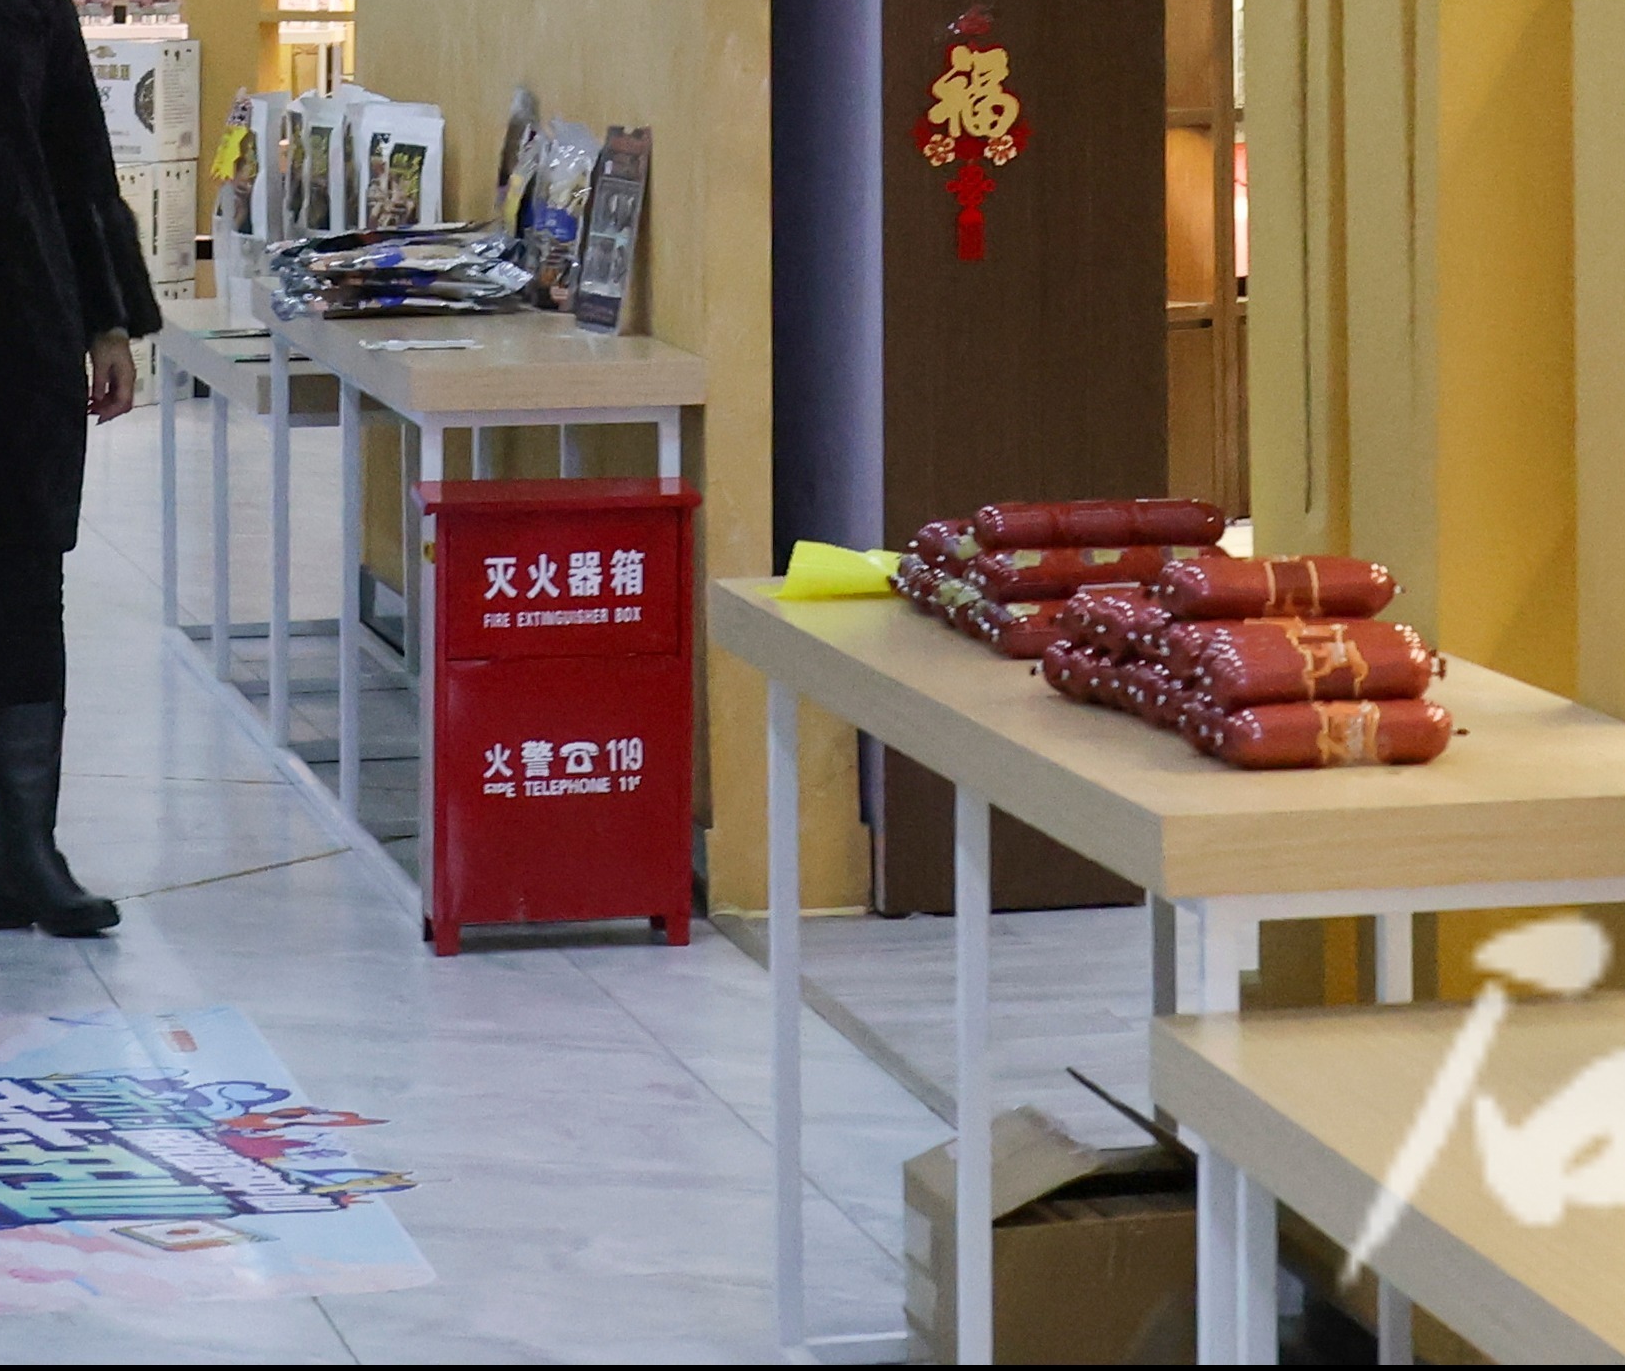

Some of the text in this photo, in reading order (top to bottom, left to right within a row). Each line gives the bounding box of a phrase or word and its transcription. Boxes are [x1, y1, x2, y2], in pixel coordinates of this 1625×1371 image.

[928, 44, 1020, 138] 福
[483, 549, 645, 600] 灭火器箱
[483, 606, 642, 628] FIRE EXTINGUISHER BOX
[483, 737, 643, 778] 火警 119
[523, 777, 611, 797] TELEPHONE
